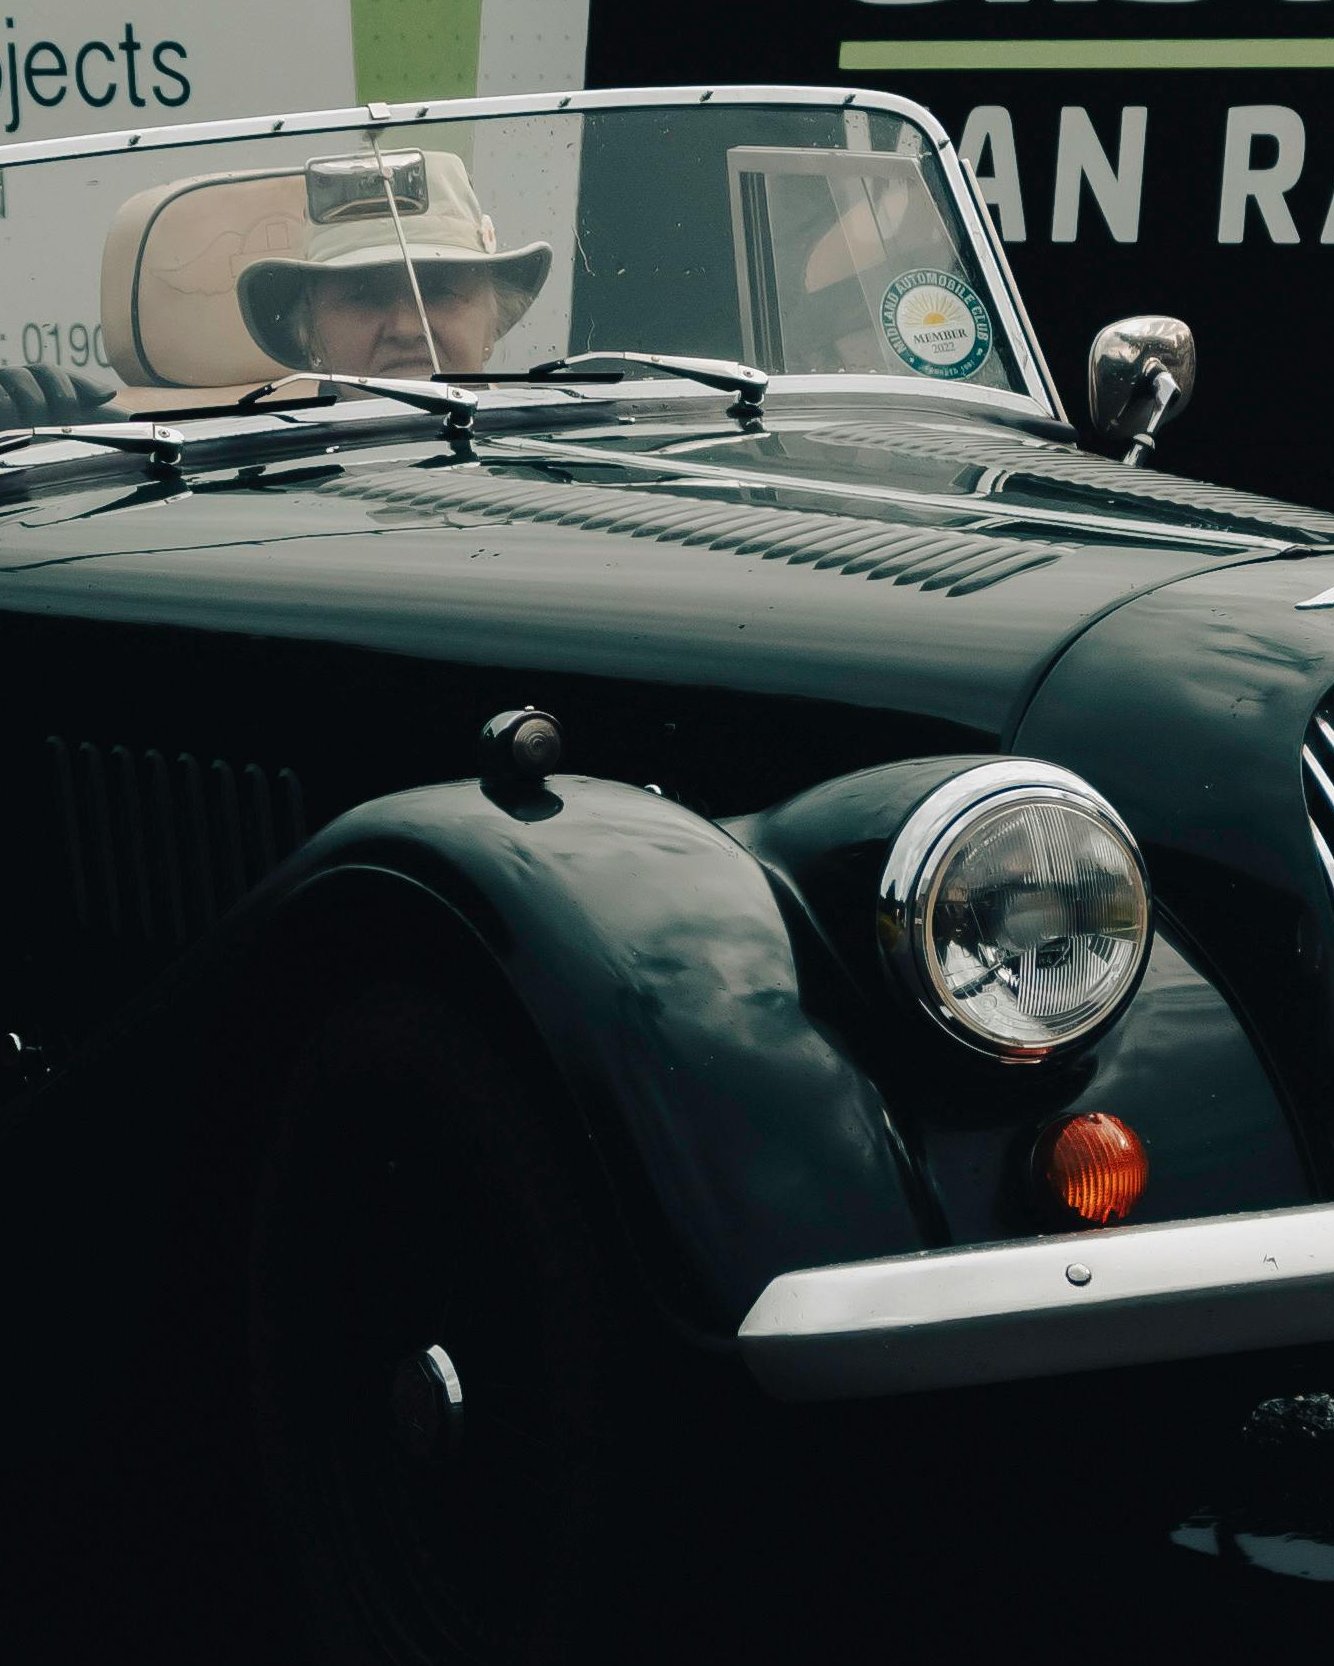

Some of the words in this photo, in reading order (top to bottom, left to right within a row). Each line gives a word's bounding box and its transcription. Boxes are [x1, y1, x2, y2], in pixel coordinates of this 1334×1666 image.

[883, 292, 907, 353] MIDLAND
[896, 272, 975, 304] AUTOMOBILE
[971, 306, 989, 341] CLUB
[913, 329, 968, 344] MEMBER
[932, 342, 956, 353] 2022
